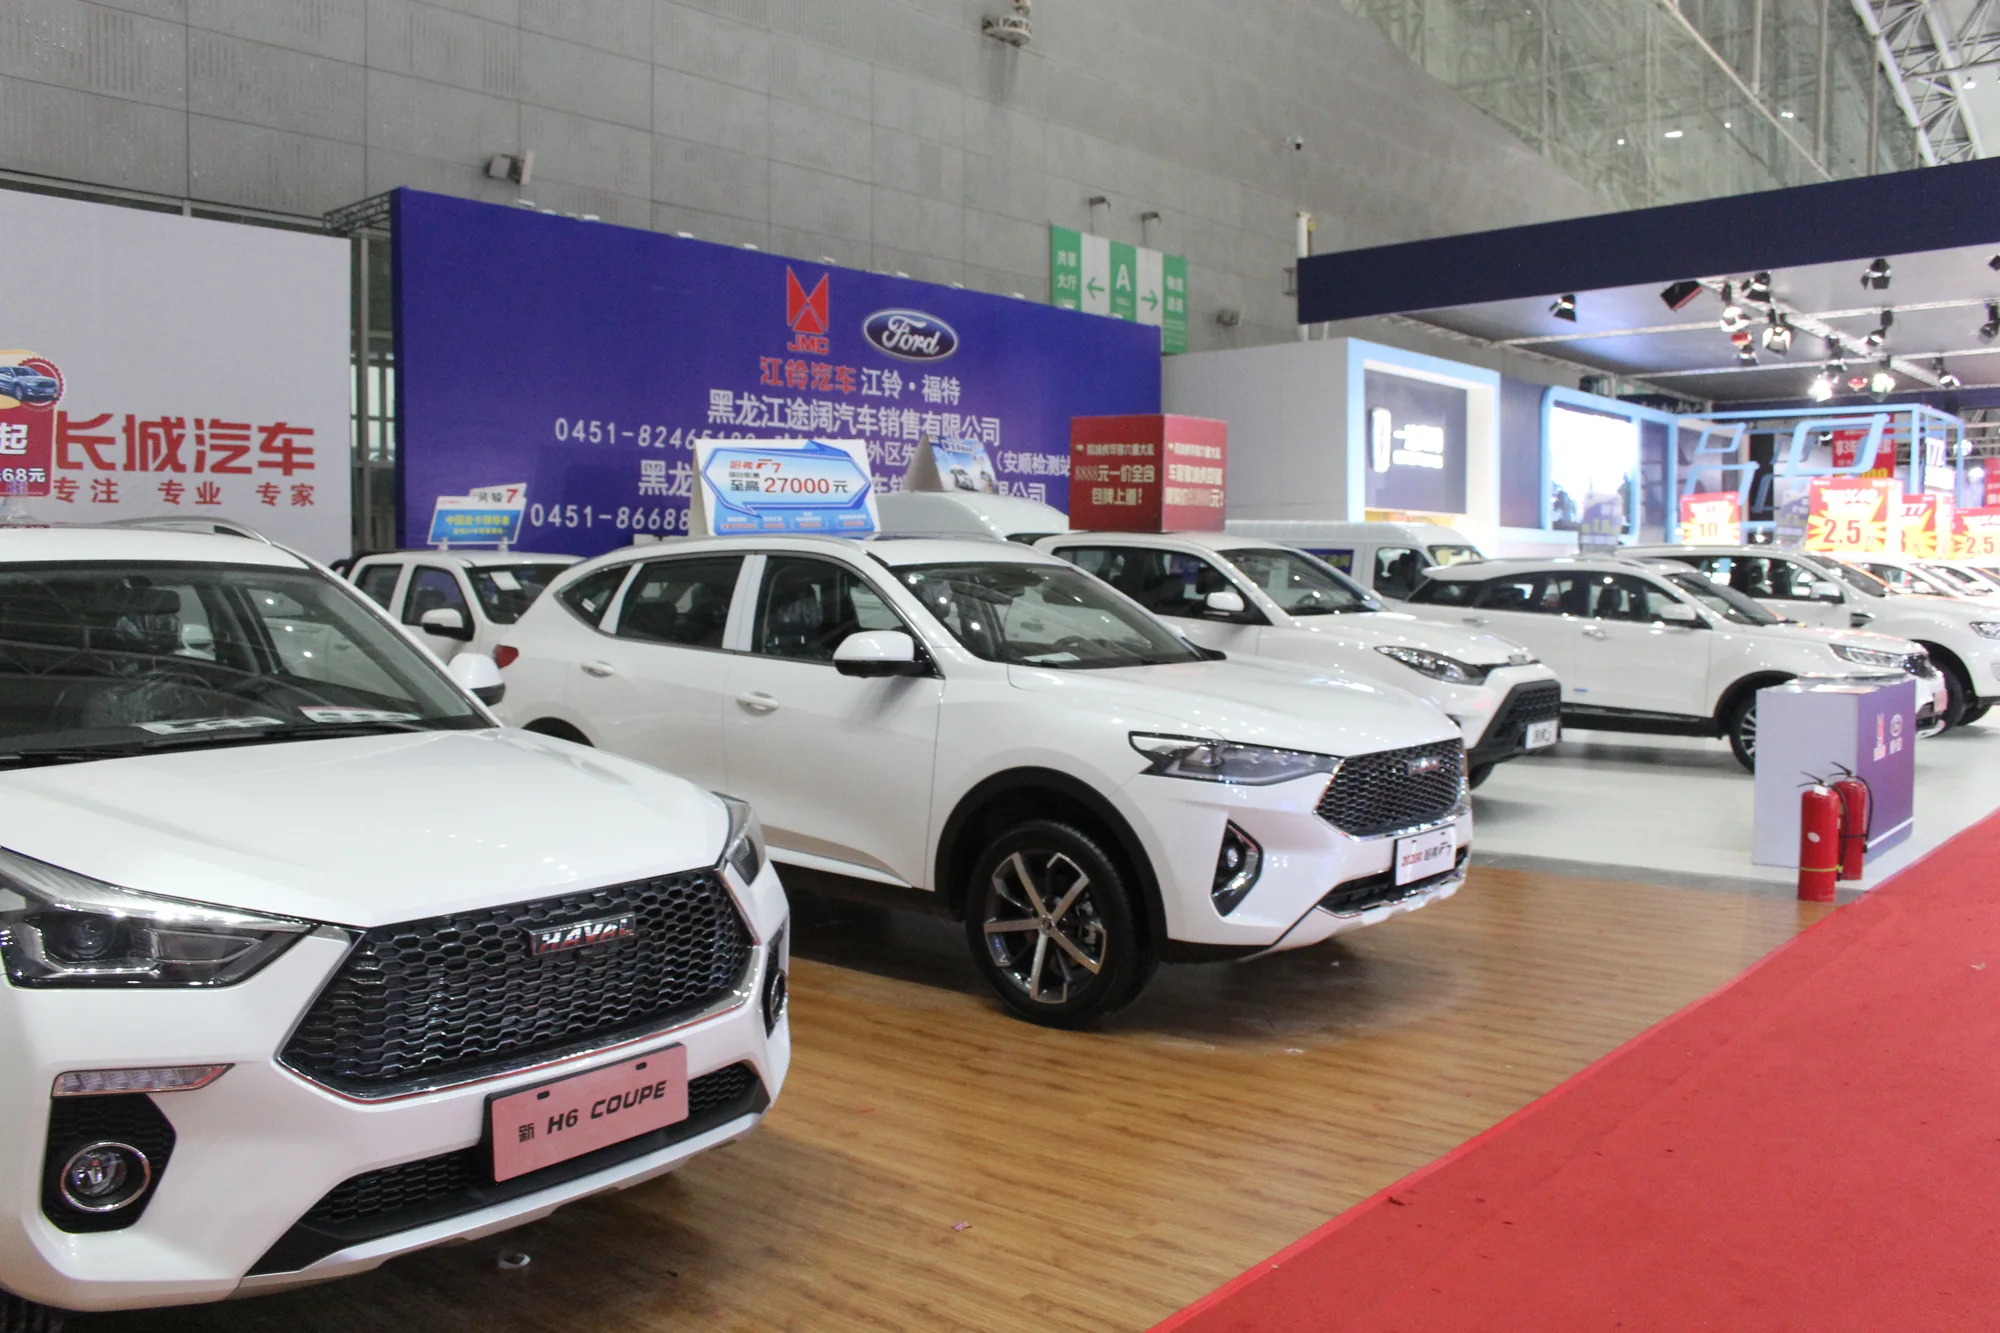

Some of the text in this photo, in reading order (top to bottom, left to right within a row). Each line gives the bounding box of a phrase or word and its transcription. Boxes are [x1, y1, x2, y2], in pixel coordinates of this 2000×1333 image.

[1056, 273, 1077, 292] 大厅
[1116, 263, 1132, 293] A
[787, 334, 829, 355] JMC
[881, 315, 941, 355] Ford
[760, 355, 857, 393] 江铃汽车
[707, 388, 1001, 447] 黑龙江途阔汽车销售有限公司
[55, 410, 315, 476] 长城汽车
[0, 467, 46, 483] 68元
[53, 476, 120, 503] 专注
[157, 479, 223, 506] 专业
[255, 482, 315, 508] 专家
[1823, 519, 1861, 545] 2.5
[1966, 536, 1995, 554] 2.5
[539, 918, 634, 951] HAVAL
[518, 1080, 667, 1143] 新 H6 COUPE
